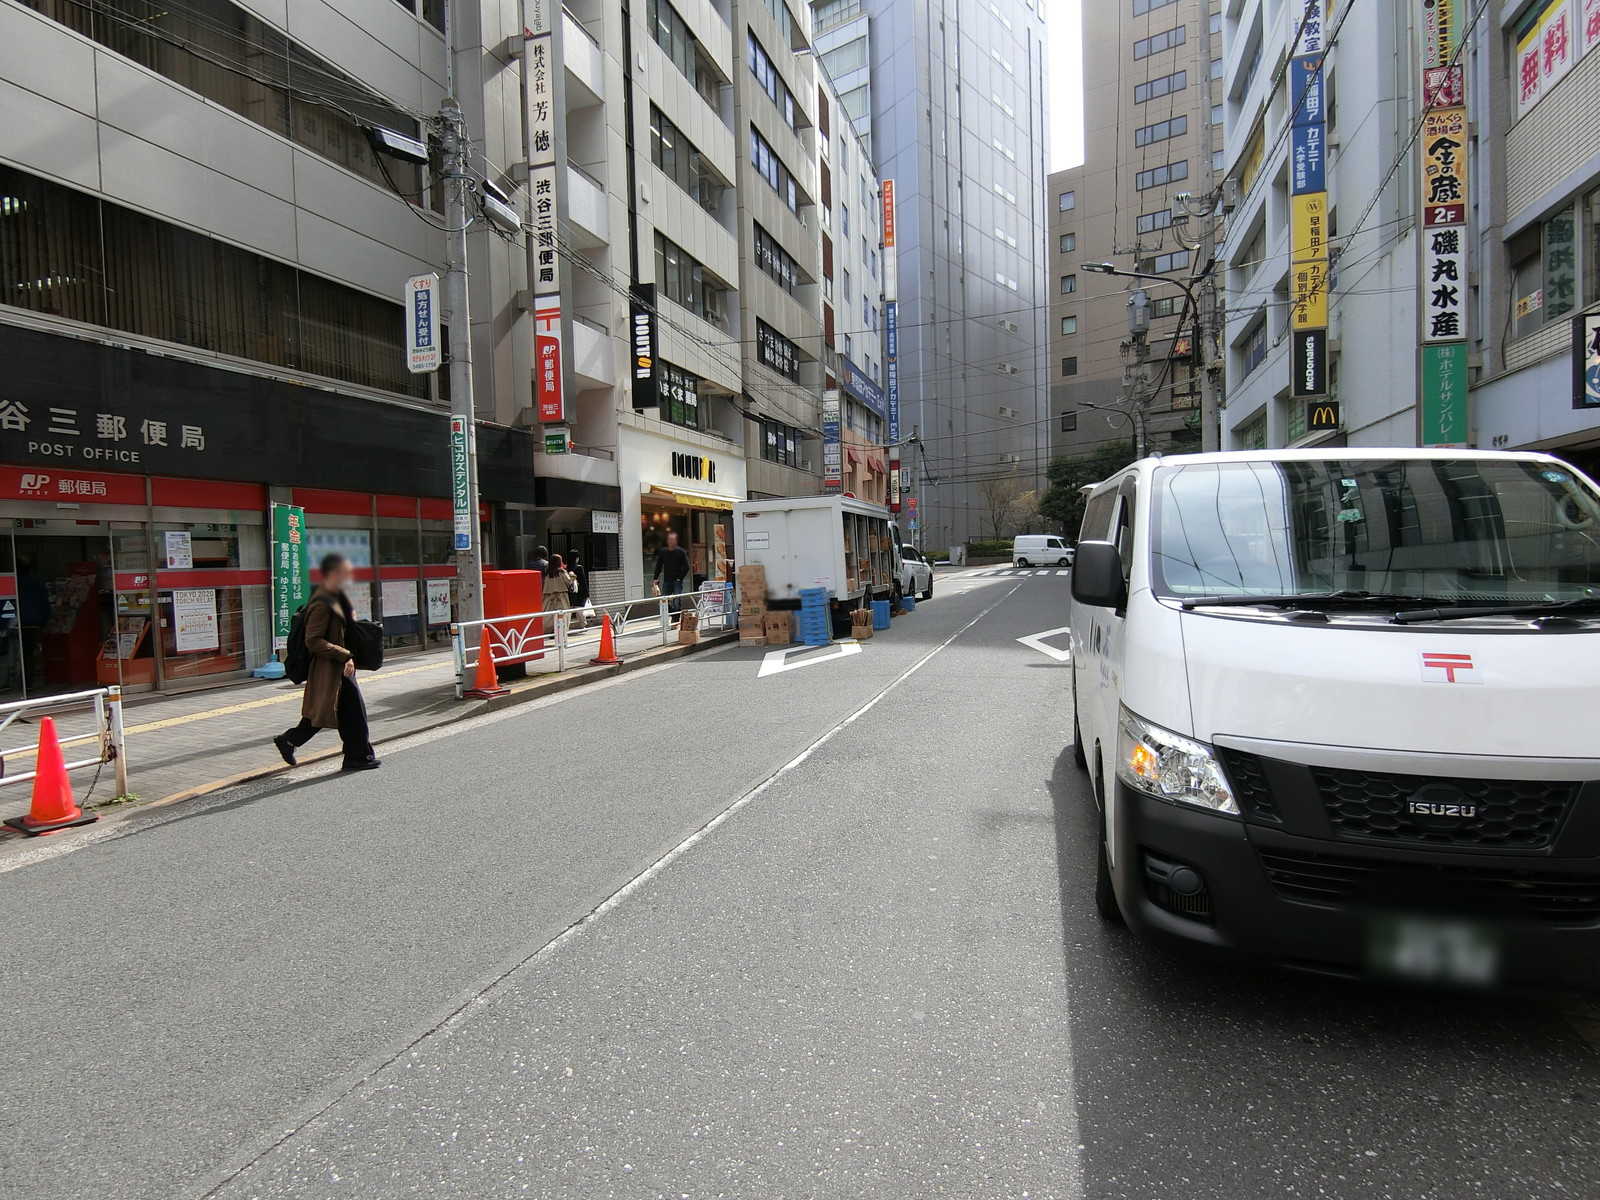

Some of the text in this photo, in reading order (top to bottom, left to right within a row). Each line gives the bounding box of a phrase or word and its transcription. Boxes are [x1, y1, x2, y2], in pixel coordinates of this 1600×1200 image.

[533, 44, 546, 95] 株式会社
[1428, 137, 1461, 203] 金の蔵
[536, 180, 554, 282] 渋谷三郵便局
[1434, 207, 1456, 223] 2F
[413, 279, 431, 289] くすり
[1431, 229, 1459, 337] 磯丸水産
[417, 291, 429, 346] 処方せん受付
[635, 314, 652, 379] DOUTOR
[1306, 336, 1315, 391] McDonald's
[544, 359, 555, 392] 郵便局
[0, 399, 206, 451] 谷三郵便局
[28, 441, 141, 463] POST OFFICE
[58, 479, 107, 496] 郵便局
[288, 514, 302, 544] 年金
[175, 590, 214, 599] TOKYO 2020
[280, 543, 290, 633] 郵便局・ゆうちょ銀行へ
[292, 544, 302, 600] のお受け取りは
[1409, 802, 1476, 817] ISUZU
